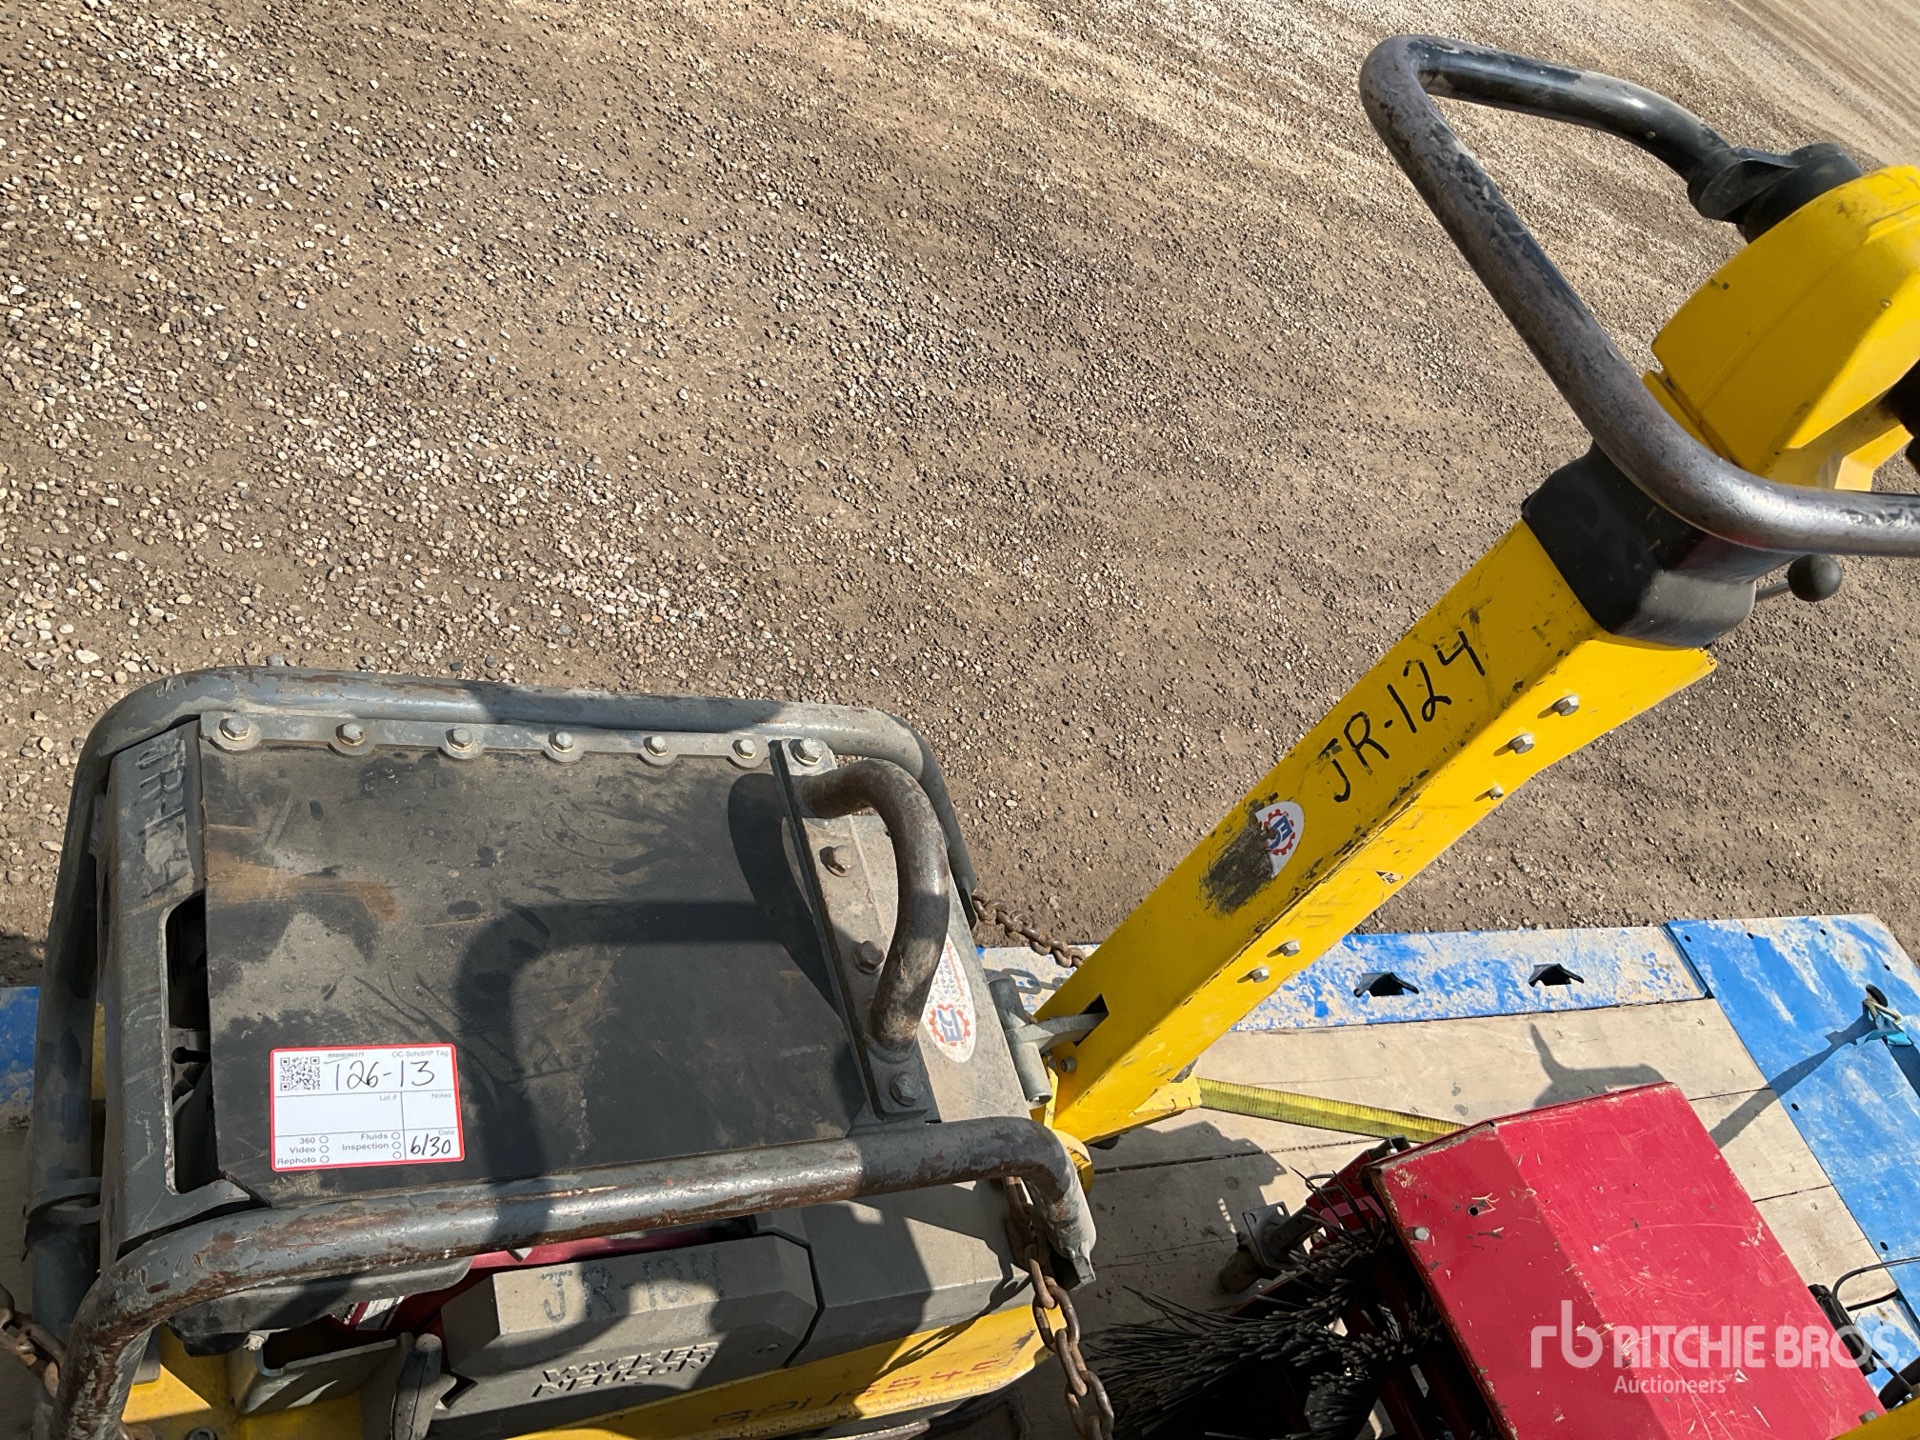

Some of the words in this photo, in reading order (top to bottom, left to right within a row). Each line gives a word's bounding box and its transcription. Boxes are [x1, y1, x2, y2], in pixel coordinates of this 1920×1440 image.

[1317, 630, 1486, 803] JR-124
[435, 1049, 450, 1059] Tag
[379, 1094, 391, 1102] Lot
[431, 1091, 452, 1100] Notes
[299, 1136, 316, 1145] 360
[360, 1131, 389, 1141] Fluids
[341, 1141, 390, 1152] Inspection
[410, 1133, 452, 1157] 6/30
[289, 1146, 317, 1155] Video
[277, 1156, 317, 1166] Rephoto
